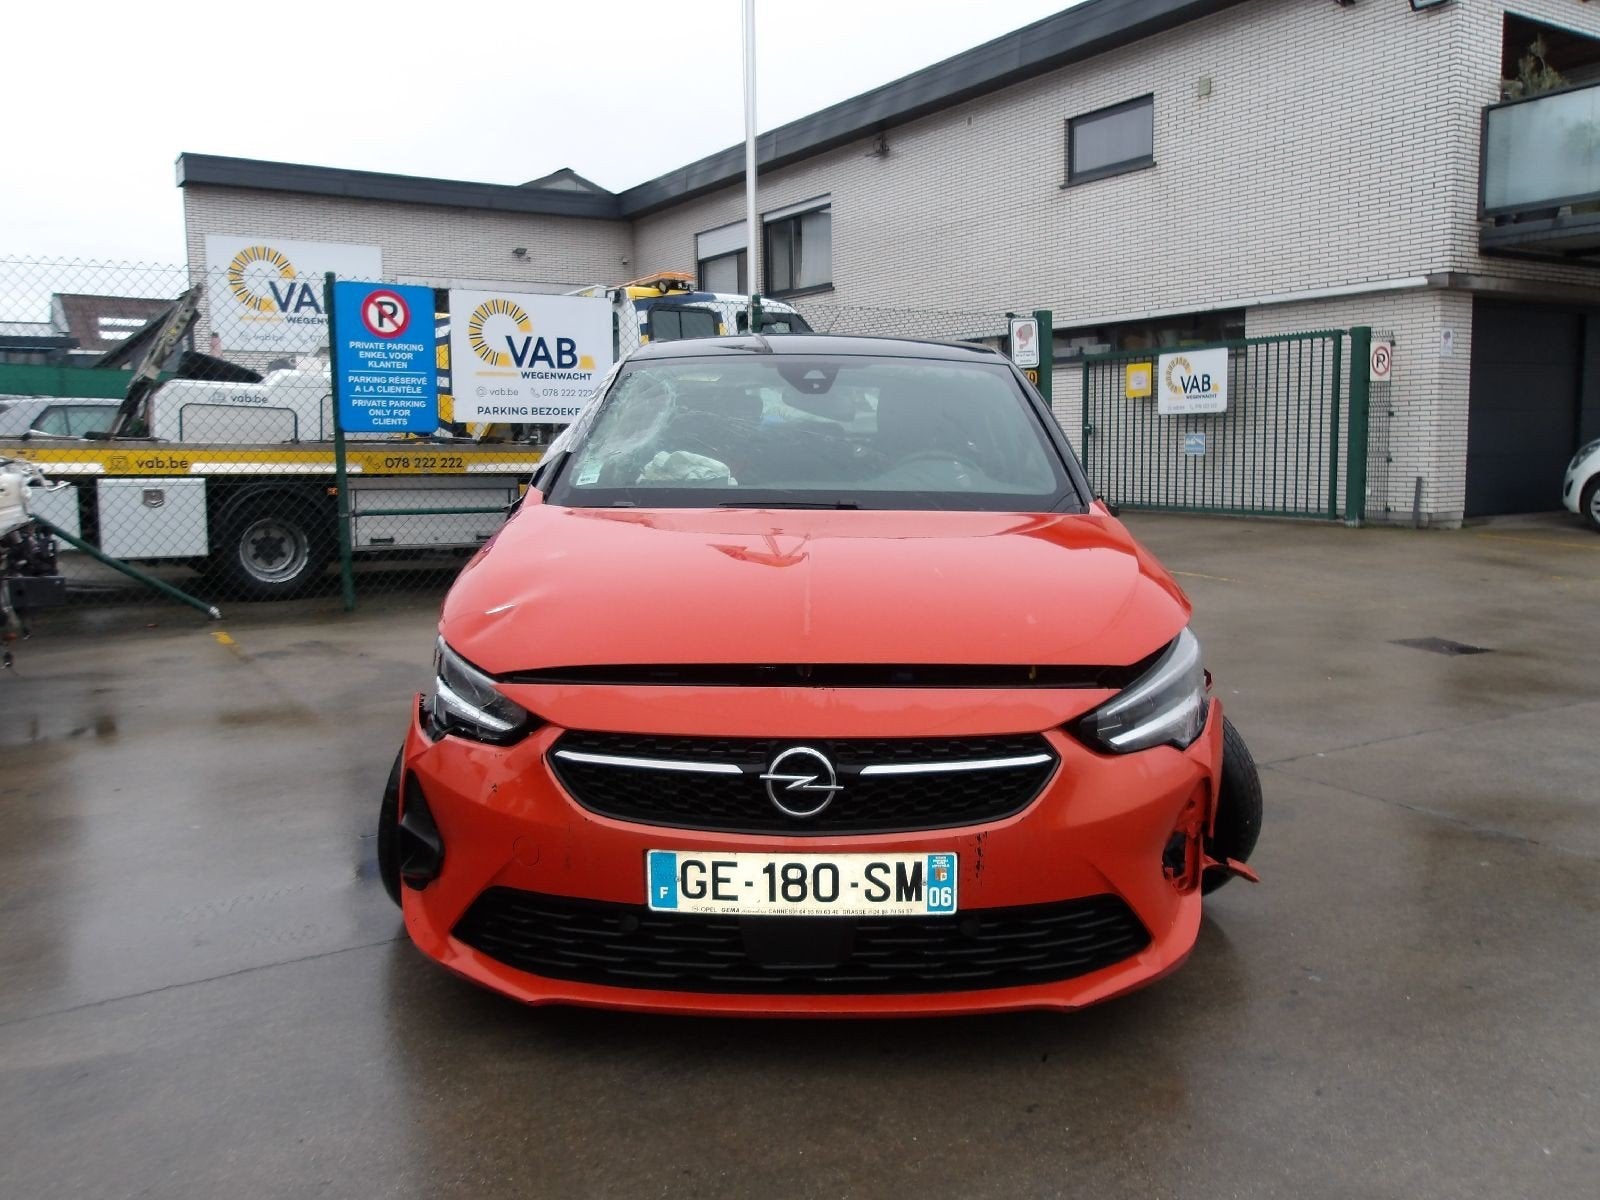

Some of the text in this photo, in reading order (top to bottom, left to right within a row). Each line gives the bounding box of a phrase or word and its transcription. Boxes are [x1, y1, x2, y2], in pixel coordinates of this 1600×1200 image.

[269, 281, 323, 313] VA
[349, 341, 424, 352] PRIVATE PARKING
[359, 351, 414, 360] ENKEL VOOR
[505, 335, 579, 369] VAB
[368, 360, 408, 369] KLANTEN
[348, 375, 428, 385] PARKING RÉSERVÉ
[520, 371, 593, 381] WEGENWACHT
[1180, 373, 1212, 394] VAB
[363, 385, 375, 393] LA
[489, 387, 519, 396] vab.be
[542, 388, 559, 396] 078
[561, 389, 576, 397] 222
[230, 394, 268, 403] vab.be
[352, 399, 427, 408] PRIVATE PARKING
[368, 408, 391, 416] ONLY
[477, 406, 581, 416] PARKING BEZOEKE
[372, 417, 408, 425] CLIENTS
[136, 457, 188, 469] vab.be
[385, 457, 464, 469] 078 222 222
[680, 859, 924, 903] GE-180-SM
[659, 886, 669, 899] F
[929, 886, 952, 907] 06
